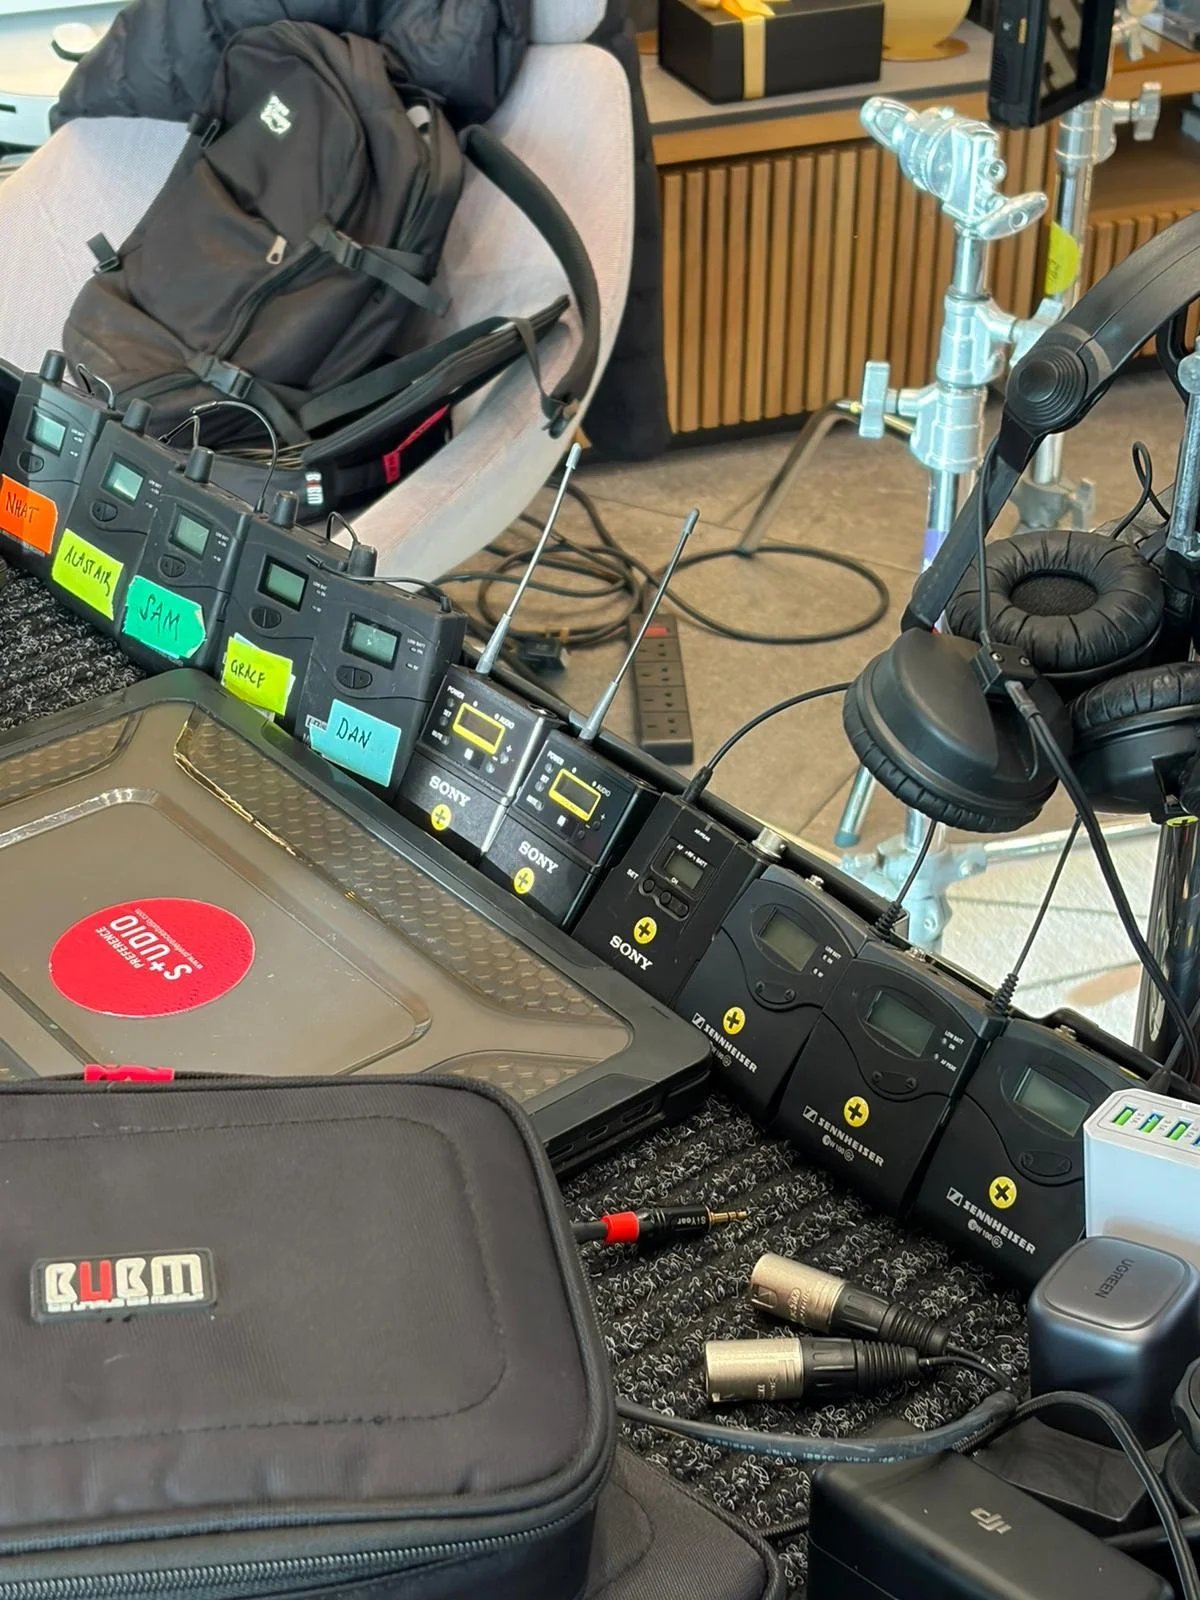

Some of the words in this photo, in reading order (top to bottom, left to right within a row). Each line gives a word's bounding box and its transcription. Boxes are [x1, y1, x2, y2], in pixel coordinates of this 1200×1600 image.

[6, 491, 39, 523] NHAT
[139, 593, 181, 641] SAM
[336, 717, 372, 749] DAN
[429, 775, 471, 807] SONY
[518, 840, 559, 874] SONY
[626, 868, 639, 880] SET
[95, 926, 145, 969] PREFERENCE
[610, 935, 653, 970] SONY
[703, 1023, 758, 1073] SENNHEISER
[818, 1117, 884, 1167] SENNHEISER
[963, 1200, 1036, 1255] SENNHEISER
[44, 1253, 204, 1304] BUBM
[1094, 1258, 1136, 1298] UGREEN
